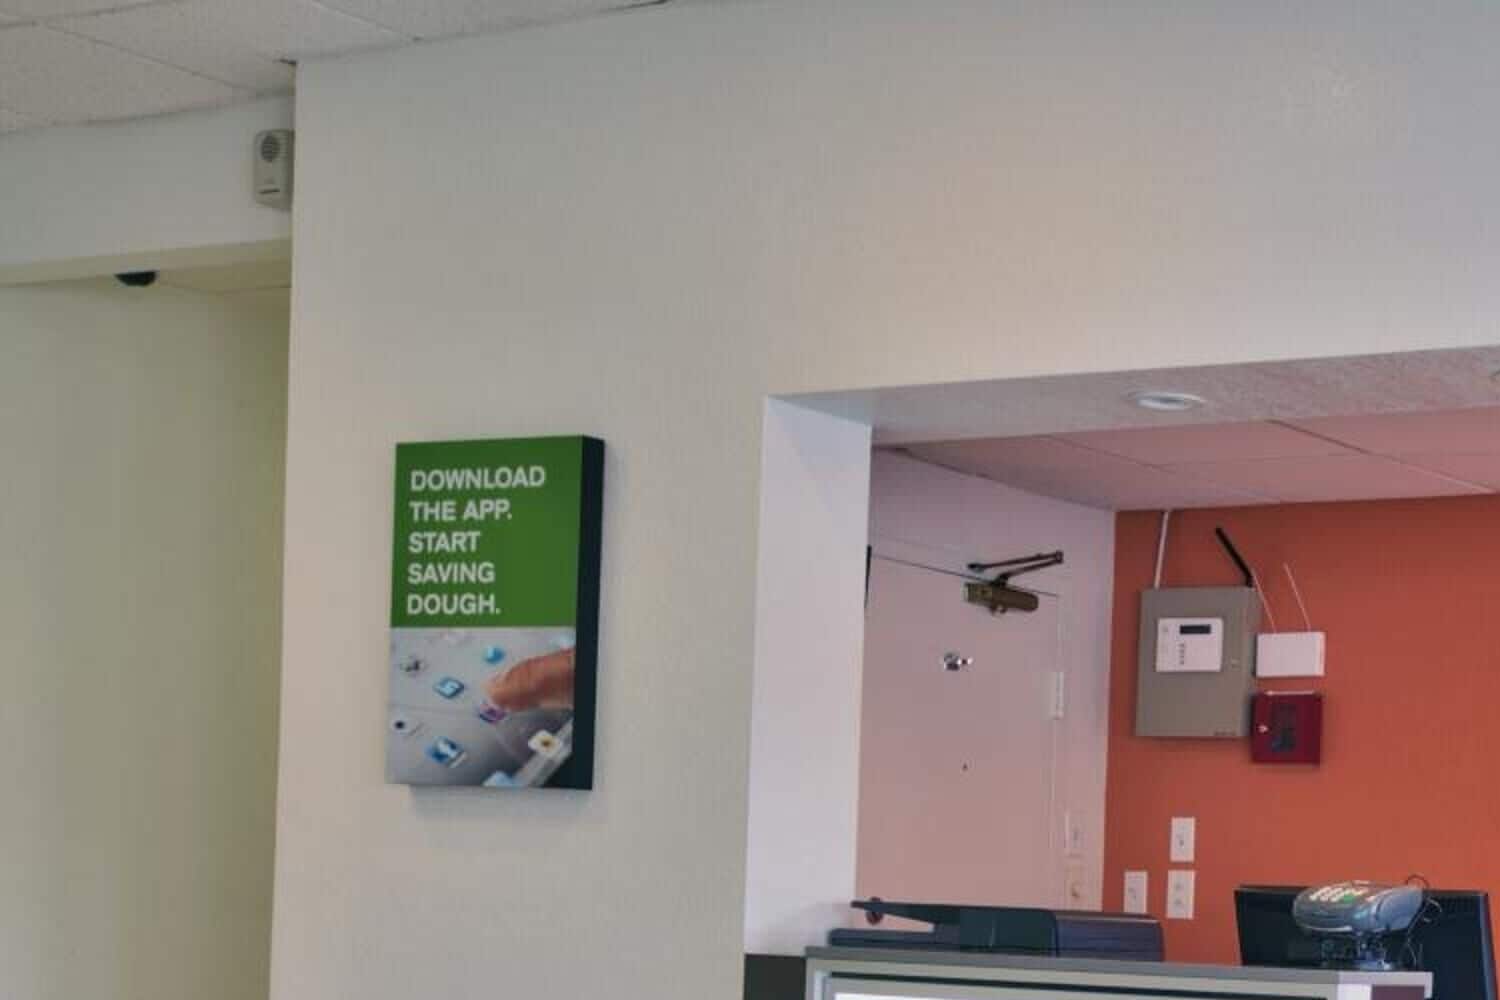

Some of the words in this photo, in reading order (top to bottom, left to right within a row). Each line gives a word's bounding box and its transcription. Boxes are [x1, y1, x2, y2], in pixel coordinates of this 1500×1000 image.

[410, 465, 546, 491] DOWNLOAD
[409, 501, 456, 522] THE
[463, 498, 512, 521] APP.
[408, 531, 481, 553] START
[407, 561, 496, 585] SAVING
[406, 593, 501, 616] DOUGH.
